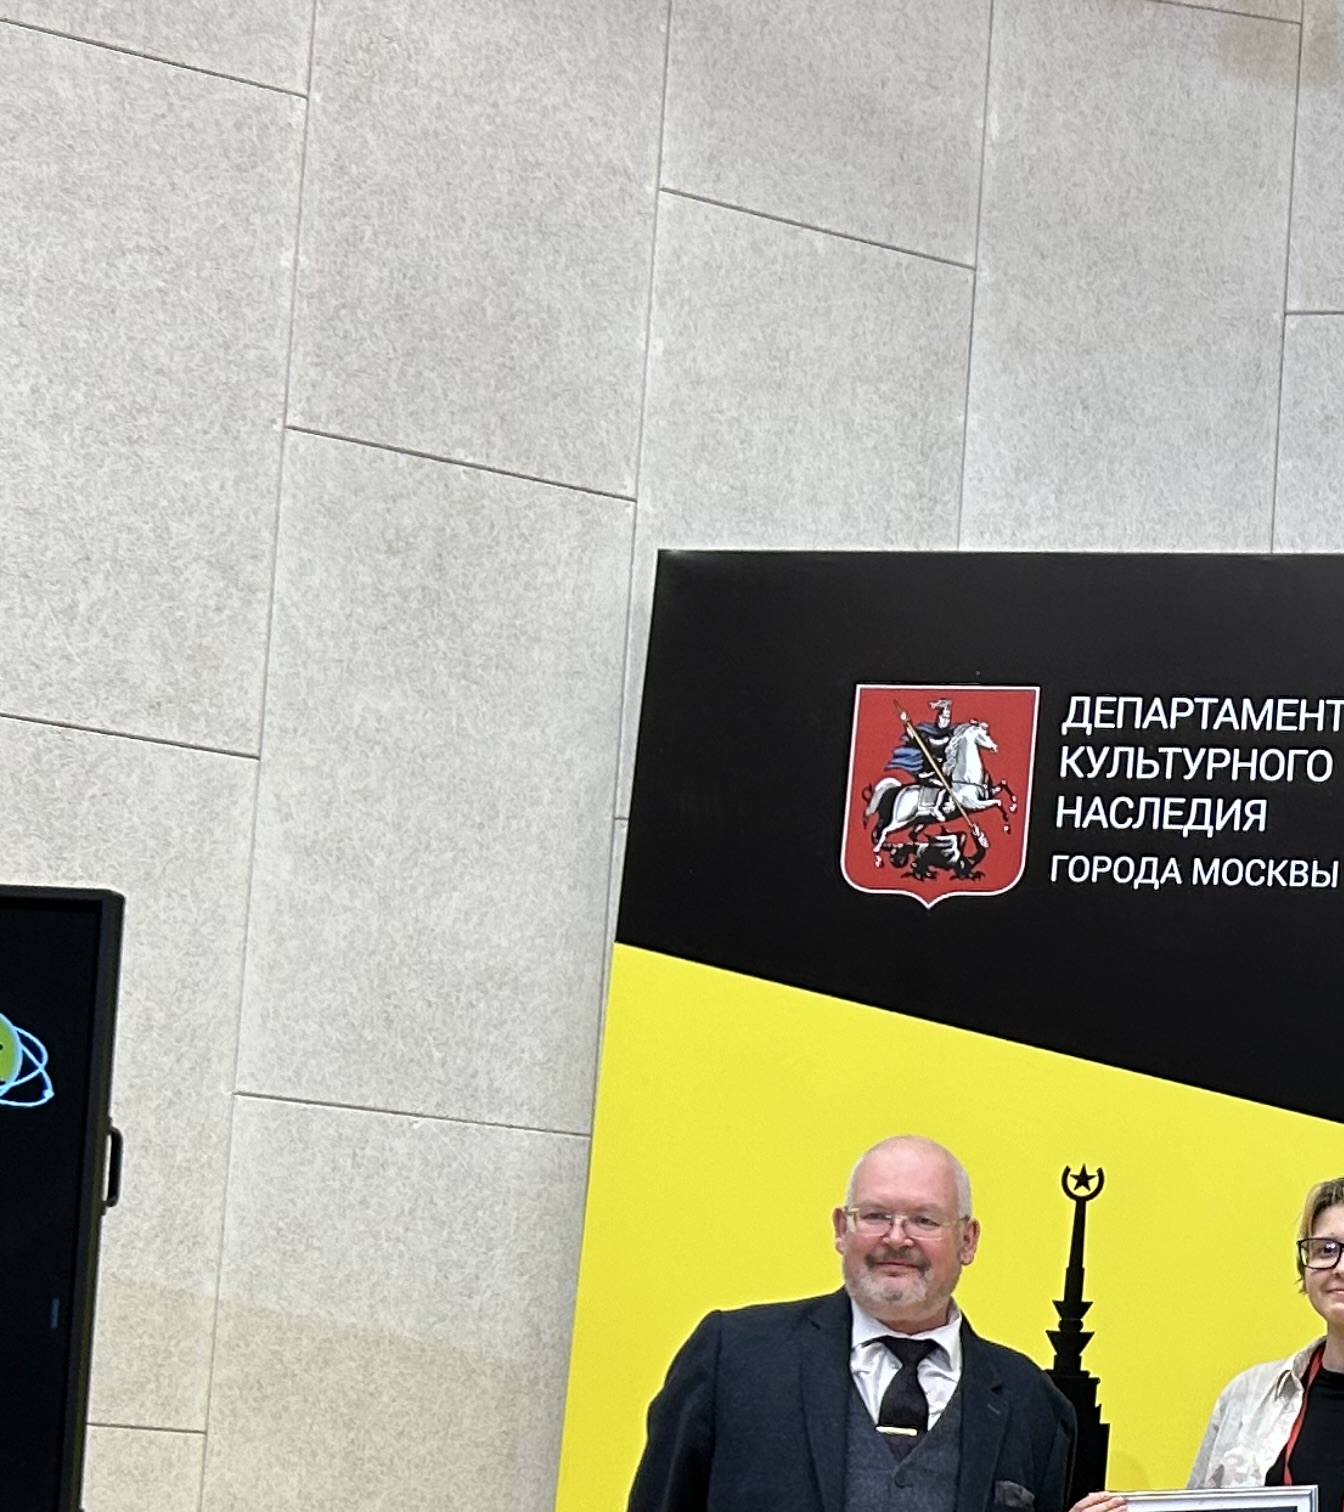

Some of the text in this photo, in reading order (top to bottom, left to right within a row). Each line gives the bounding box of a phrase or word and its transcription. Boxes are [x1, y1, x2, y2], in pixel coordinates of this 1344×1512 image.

[1058, 745, 1334, 783] КУЛЬТУРНОГО
[1055, 795, 1267, 837] НАСЛЕДИЯ
[1050, 854, 1340, 890] ГОРОДА МОСКВЫ
